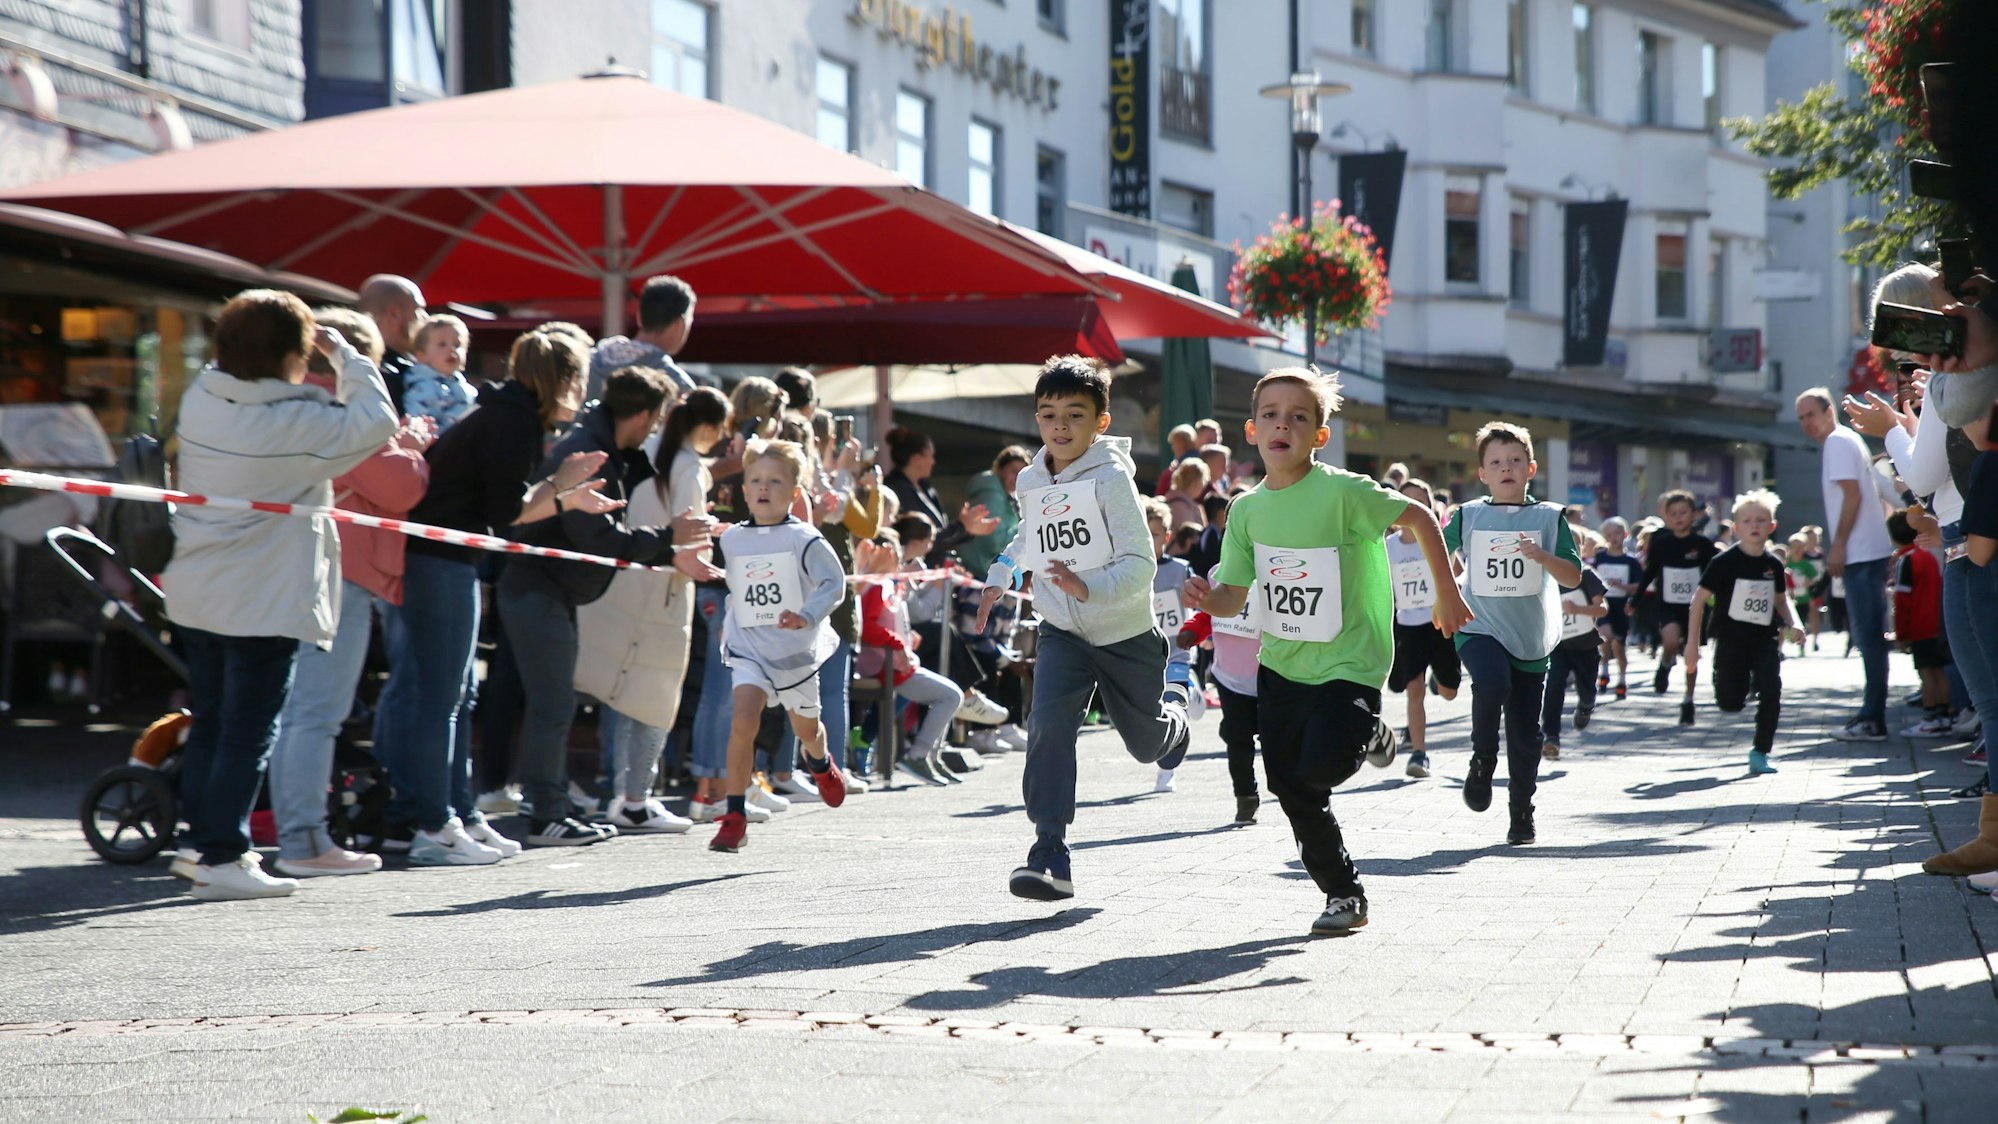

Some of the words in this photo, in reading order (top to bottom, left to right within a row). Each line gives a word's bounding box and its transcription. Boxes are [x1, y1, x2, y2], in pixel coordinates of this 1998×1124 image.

[1110, 58, 1136, 163] Gold
[1037, 518, 1091, 553] 1056
[1486, 558, 1524, 579] 510
[744, 582, 782, 607] 483
[1402, 579, 1428, 597] 774
[1671, 583, 1692, 594] 953
[1263, 582, 1324, 616] 1267
[1743, 598, 1768, 613] 938
[755, 612, 774, 620] Fritz
[1233, 623, 1256, 634] Rafael
[1281, 622, 1301, 633] Ben
